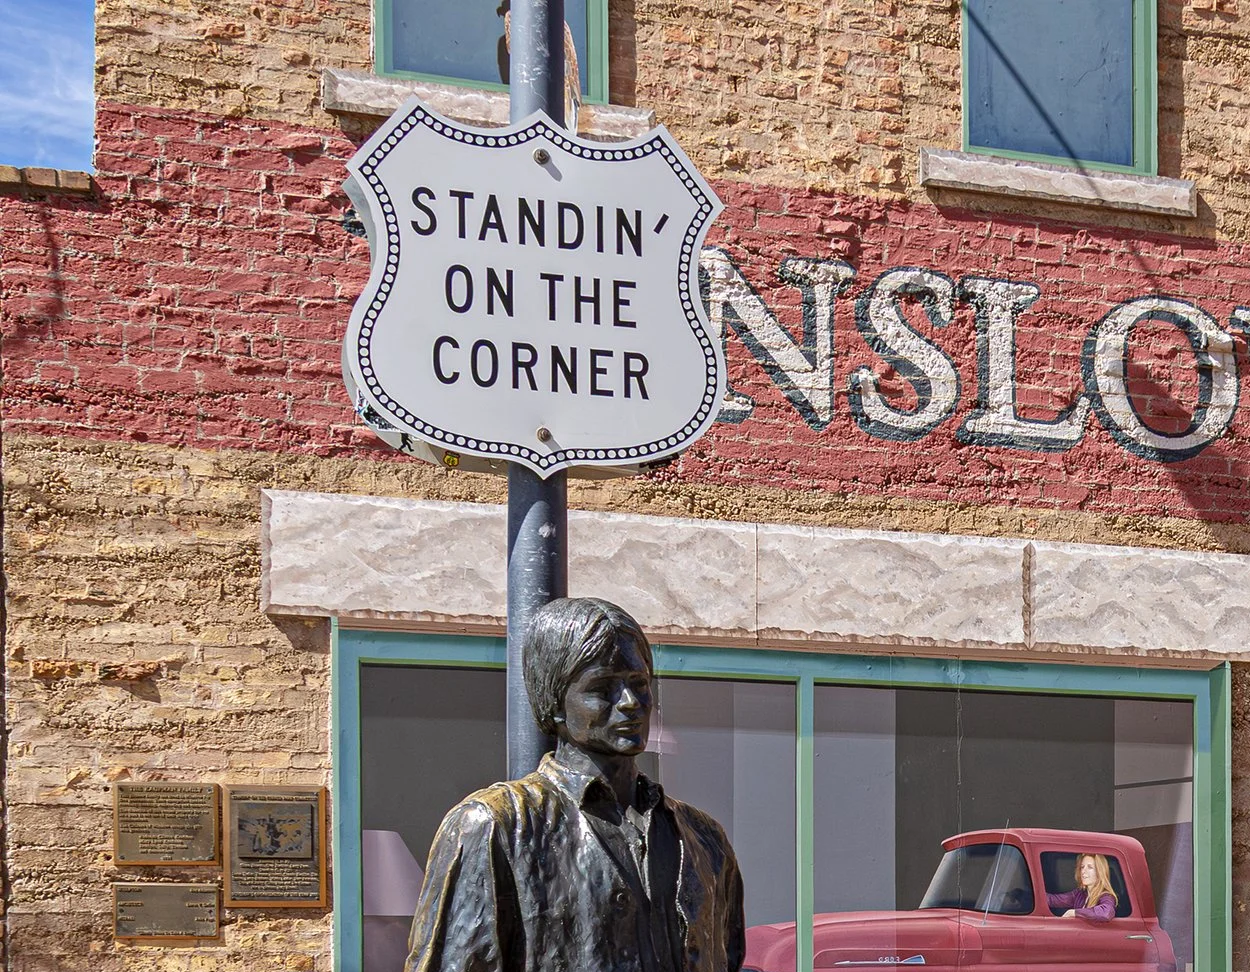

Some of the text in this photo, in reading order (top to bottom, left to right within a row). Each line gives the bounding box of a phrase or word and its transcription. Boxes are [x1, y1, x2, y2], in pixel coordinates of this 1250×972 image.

[411, 186, 669, 258] STANDIN'
[445, 265, 638, 329] ON THE
[432, 335, 650, 401] CORNER
